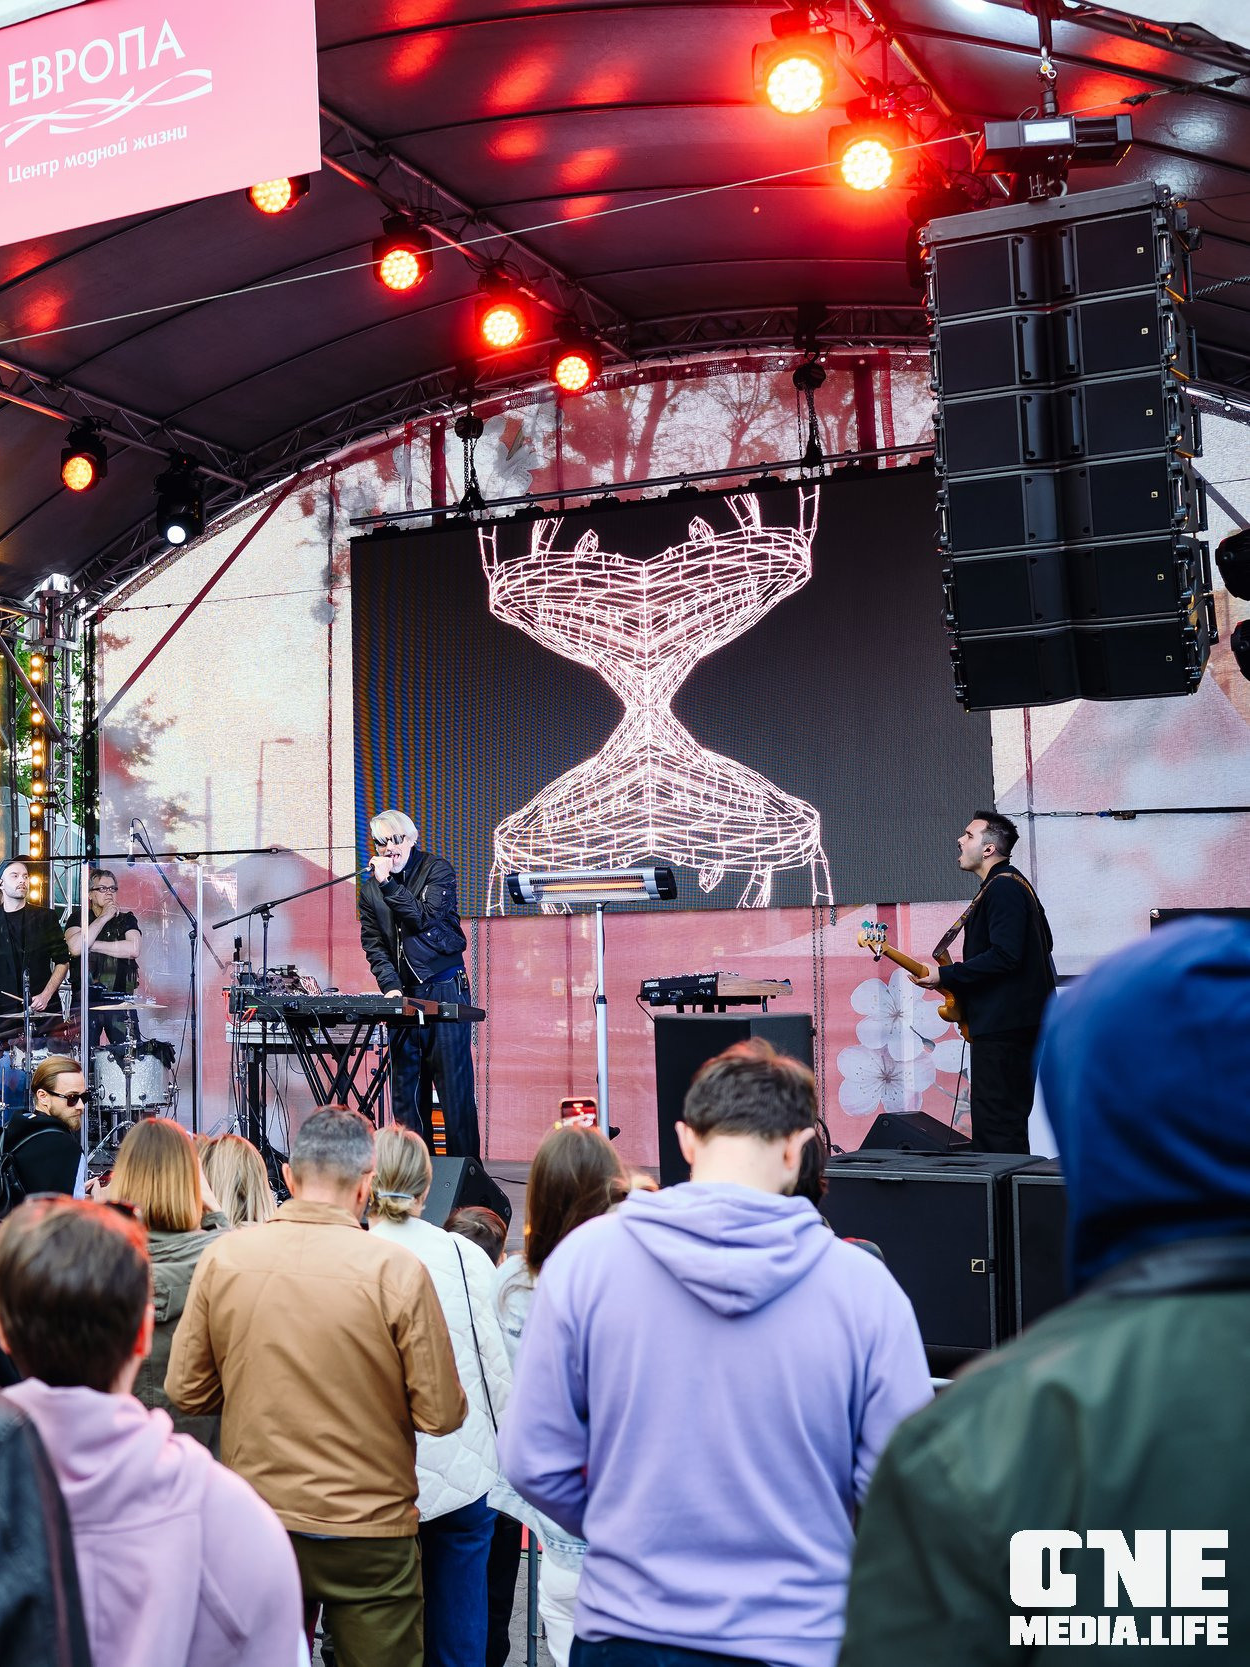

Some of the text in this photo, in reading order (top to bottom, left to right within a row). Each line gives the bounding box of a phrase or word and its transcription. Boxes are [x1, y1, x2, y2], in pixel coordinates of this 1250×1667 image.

[8, 18, 186, 107] ЕВРОПА
[8, 125, 188, 184] Центр модной жизни
